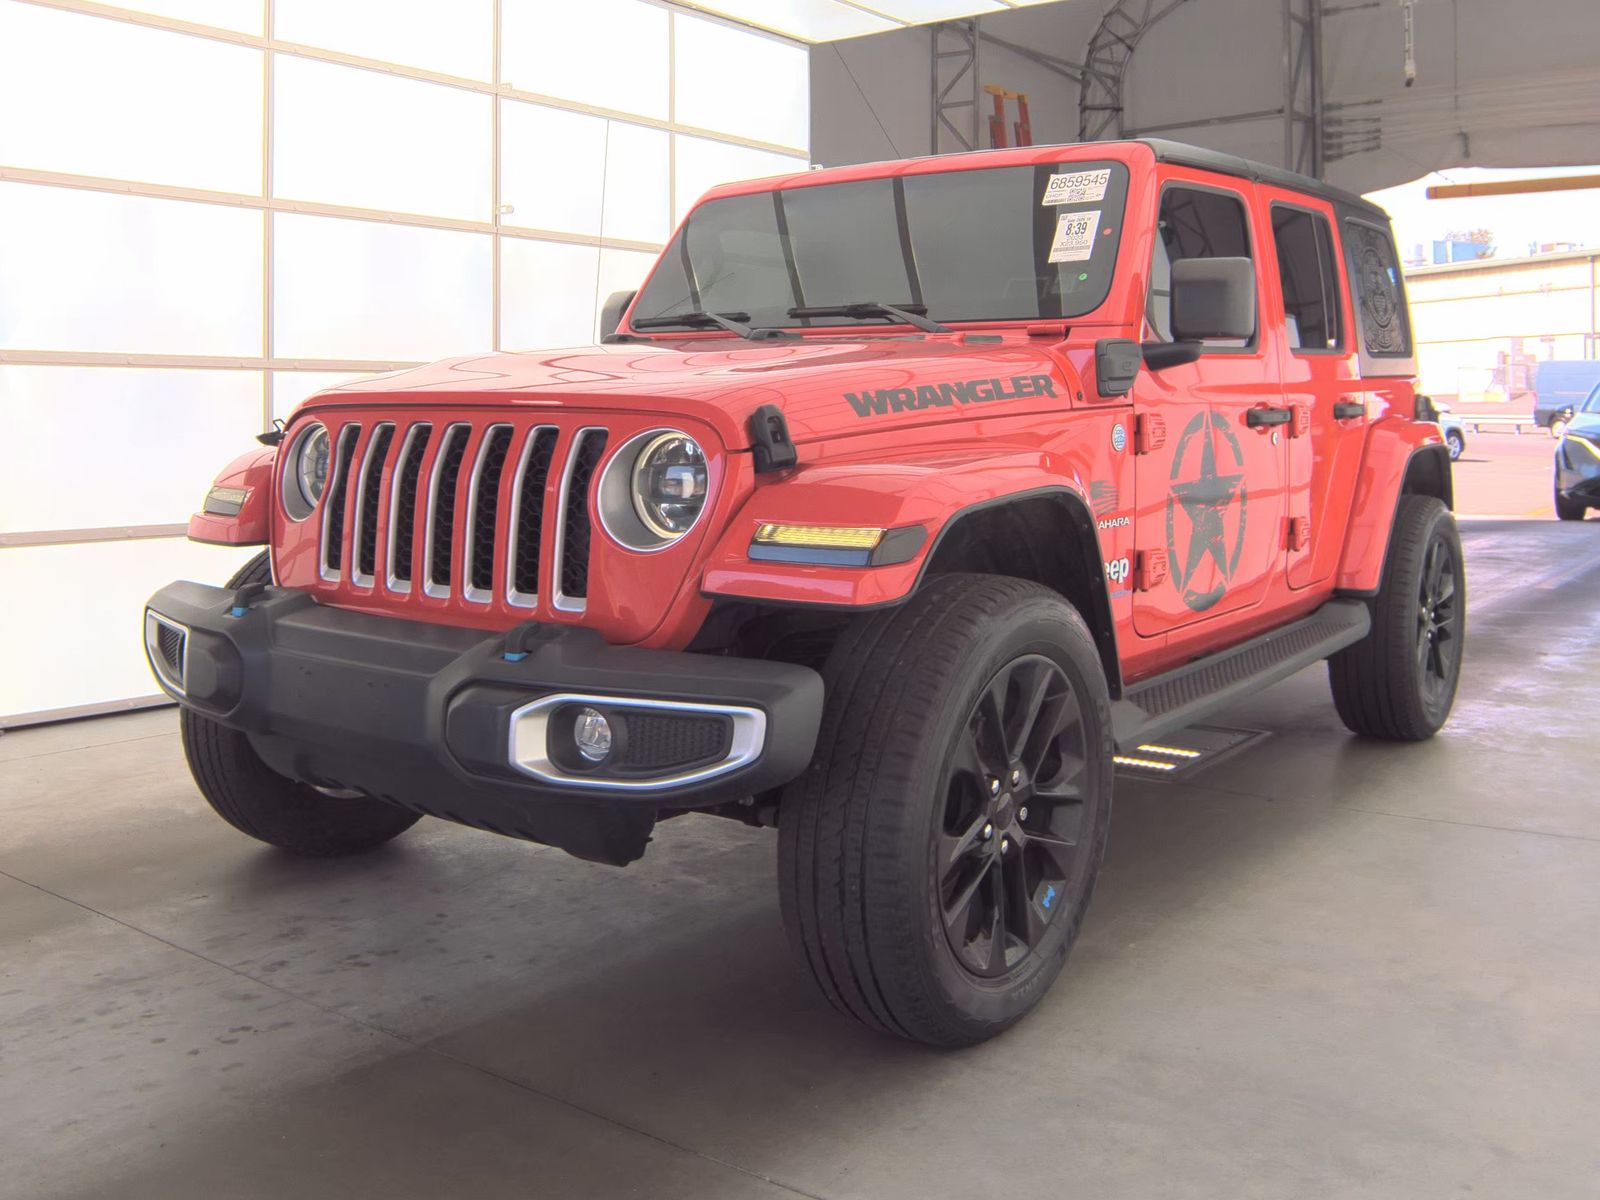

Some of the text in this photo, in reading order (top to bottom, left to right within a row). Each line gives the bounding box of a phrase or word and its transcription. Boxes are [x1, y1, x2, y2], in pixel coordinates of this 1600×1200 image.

[1051, 173, 1108, 190] 6859545
[1066, 222, 1087, 236] 8:39
[843, 374, 1058, 417] WRANGLER
[1097, 516, 1130, 529] AHARA
[1105, 558, 1129, 584] eep
